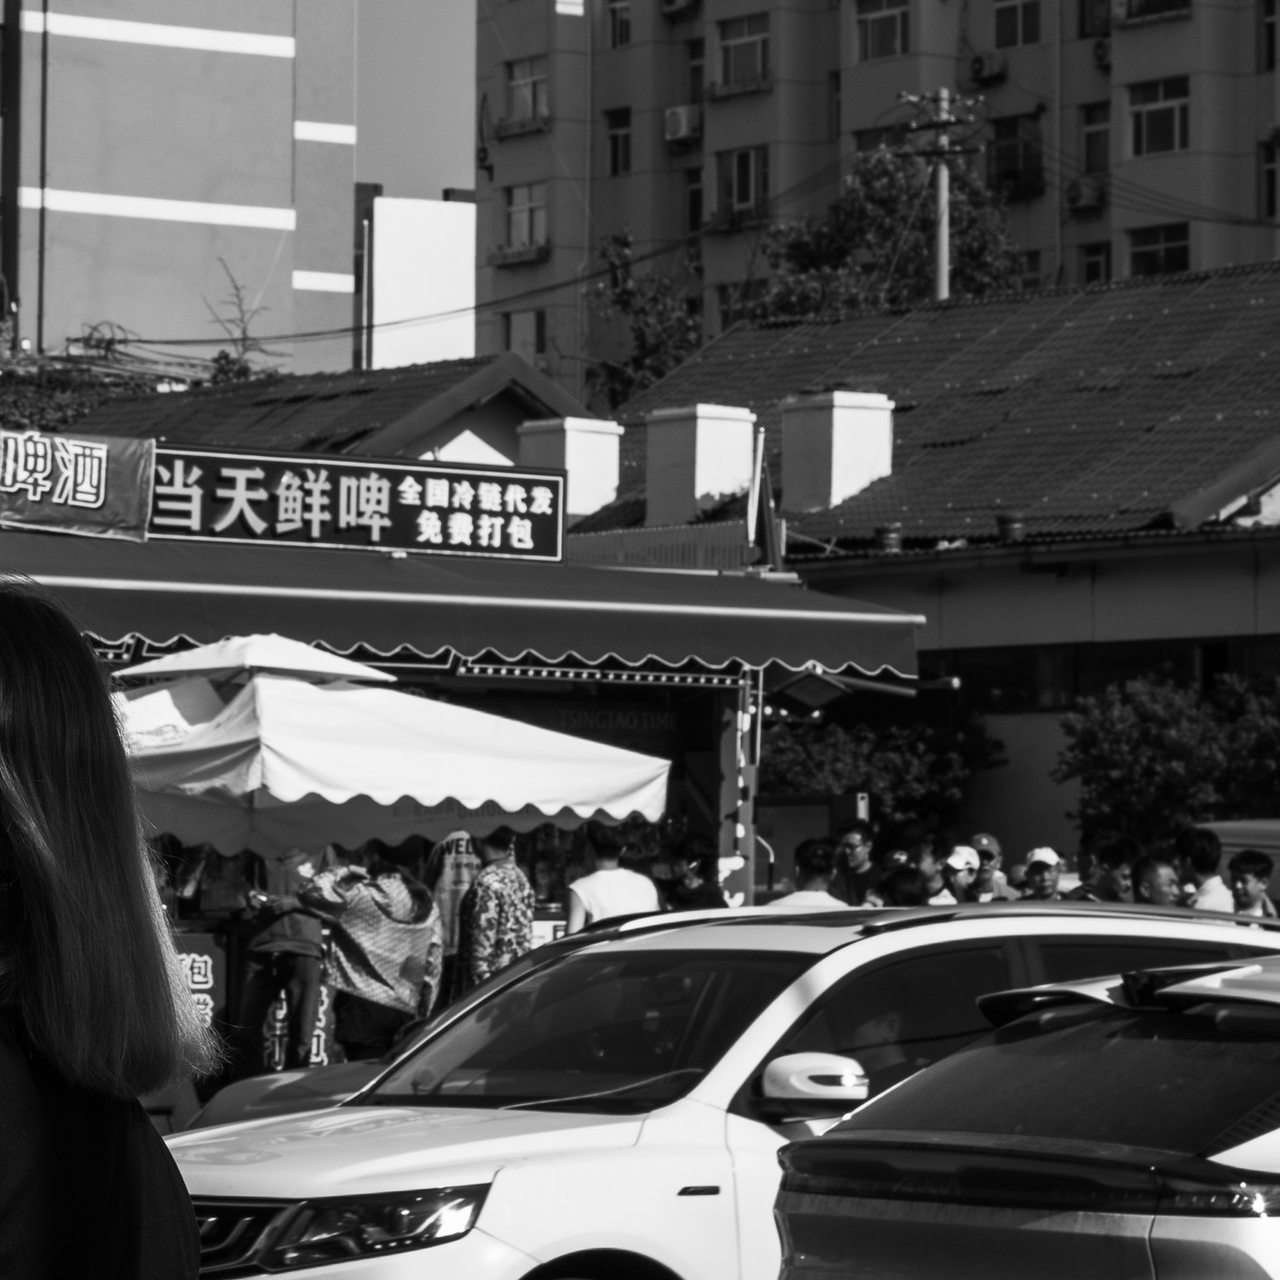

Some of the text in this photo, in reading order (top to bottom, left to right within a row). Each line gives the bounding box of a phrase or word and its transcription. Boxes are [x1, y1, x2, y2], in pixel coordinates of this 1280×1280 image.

[153, 459, 392, 543] 当天鲜啤
[397, 475, 554, 516] 全国冷链代发
[415, 509, 535, 550] 免费打包
[558, 708, 678, 732] TSINGTAO TIME
